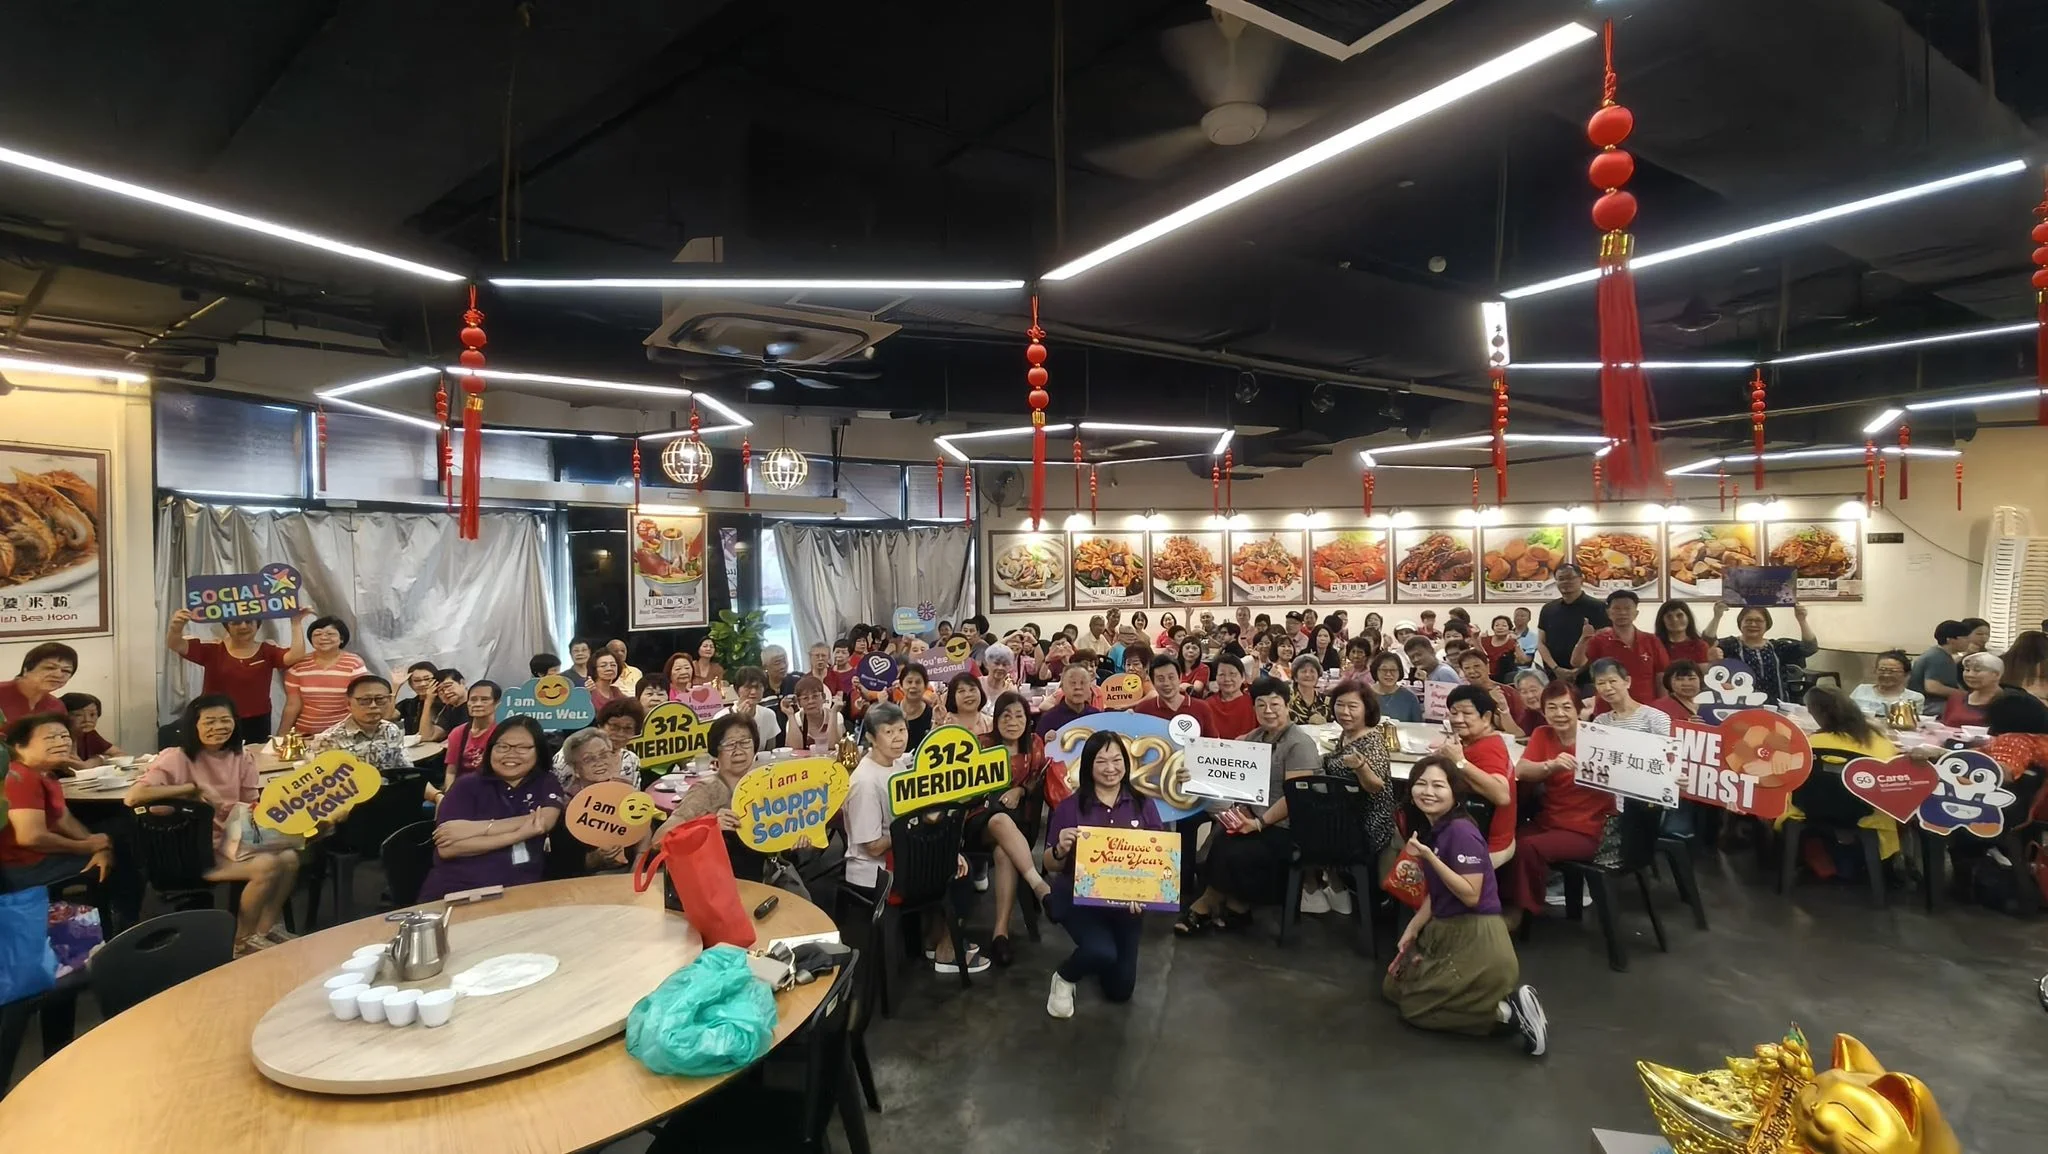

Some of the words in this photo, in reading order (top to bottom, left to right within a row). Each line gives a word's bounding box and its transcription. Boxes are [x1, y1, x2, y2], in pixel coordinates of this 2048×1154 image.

[189, 584, 265, 606] SOCIAL
[47, 613, 78, 621] Hoon
[191, 595, 297, 620] COHESION
[926, 662, 966, 675] wesome!
[506, 696, 511, 707] I
[514, 698, 535, 707] am
[651, 714, 692, 736] 312
[626, 733, 707, 759] MERIDIA
[924, 740, 974, 769] 312
[1675, 727, 1722, 767] WE
[1197, 756, 1258, 770] CANBERRA
[1588, 745, 1665, 775] 万事如意
[282, 785, 290, 795] I
[291, 772, 313, 790] am
[314, 765, 325, 775] a
[769, 778, 773, 789] I
[777, 774, 797, 788] am
[801, 769, 809, 780] a
[895, 761, 1005, 802] MERIDIAN
[1207, 768, 1237, 780] ZONE
[1239, 772, 1246, 781] 9
[1876, 774, 1911, 782] Cares
[266, 763, 355, 823] Blossom
[306, 778, 359, 822] Kaki!
[751, 783, 829, 822] Happy
[584, 795, 592, 808] I
[592, 801, 616, 816] am
[752, 805, 830, 844] Senior
[1106, 836, 1151, 853] Chinese
[1089, 850, 1125, 864] New
[1126, 852, 1164, 870] Year
